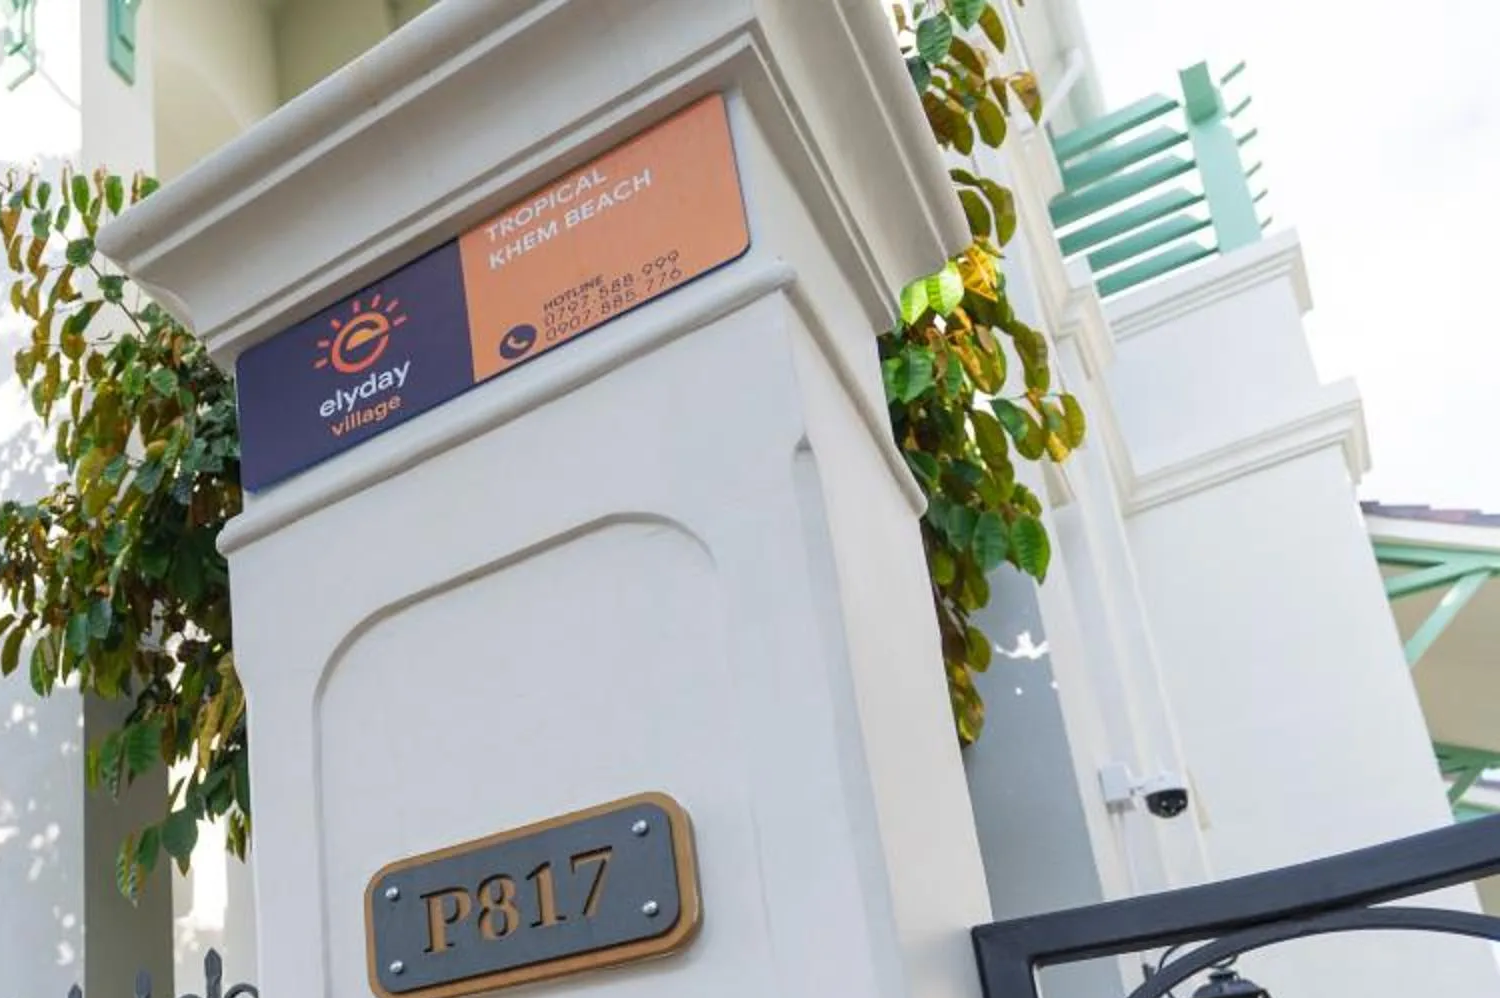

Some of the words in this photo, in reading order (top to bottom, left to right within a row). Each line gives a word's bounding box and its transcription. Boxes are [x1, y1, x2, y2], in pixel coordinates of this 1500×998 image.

[485, 168, 607, 242] TROPICAL
[489, 221, 558, 269] KHEM
[564, 168, 652, 228] BEACH
[543, 273, 604, 311] HOTLINE
[320, 360, 411, 417] elyday
[331, 395, 402, 436] village
[419, 845, 613, 954] P817
